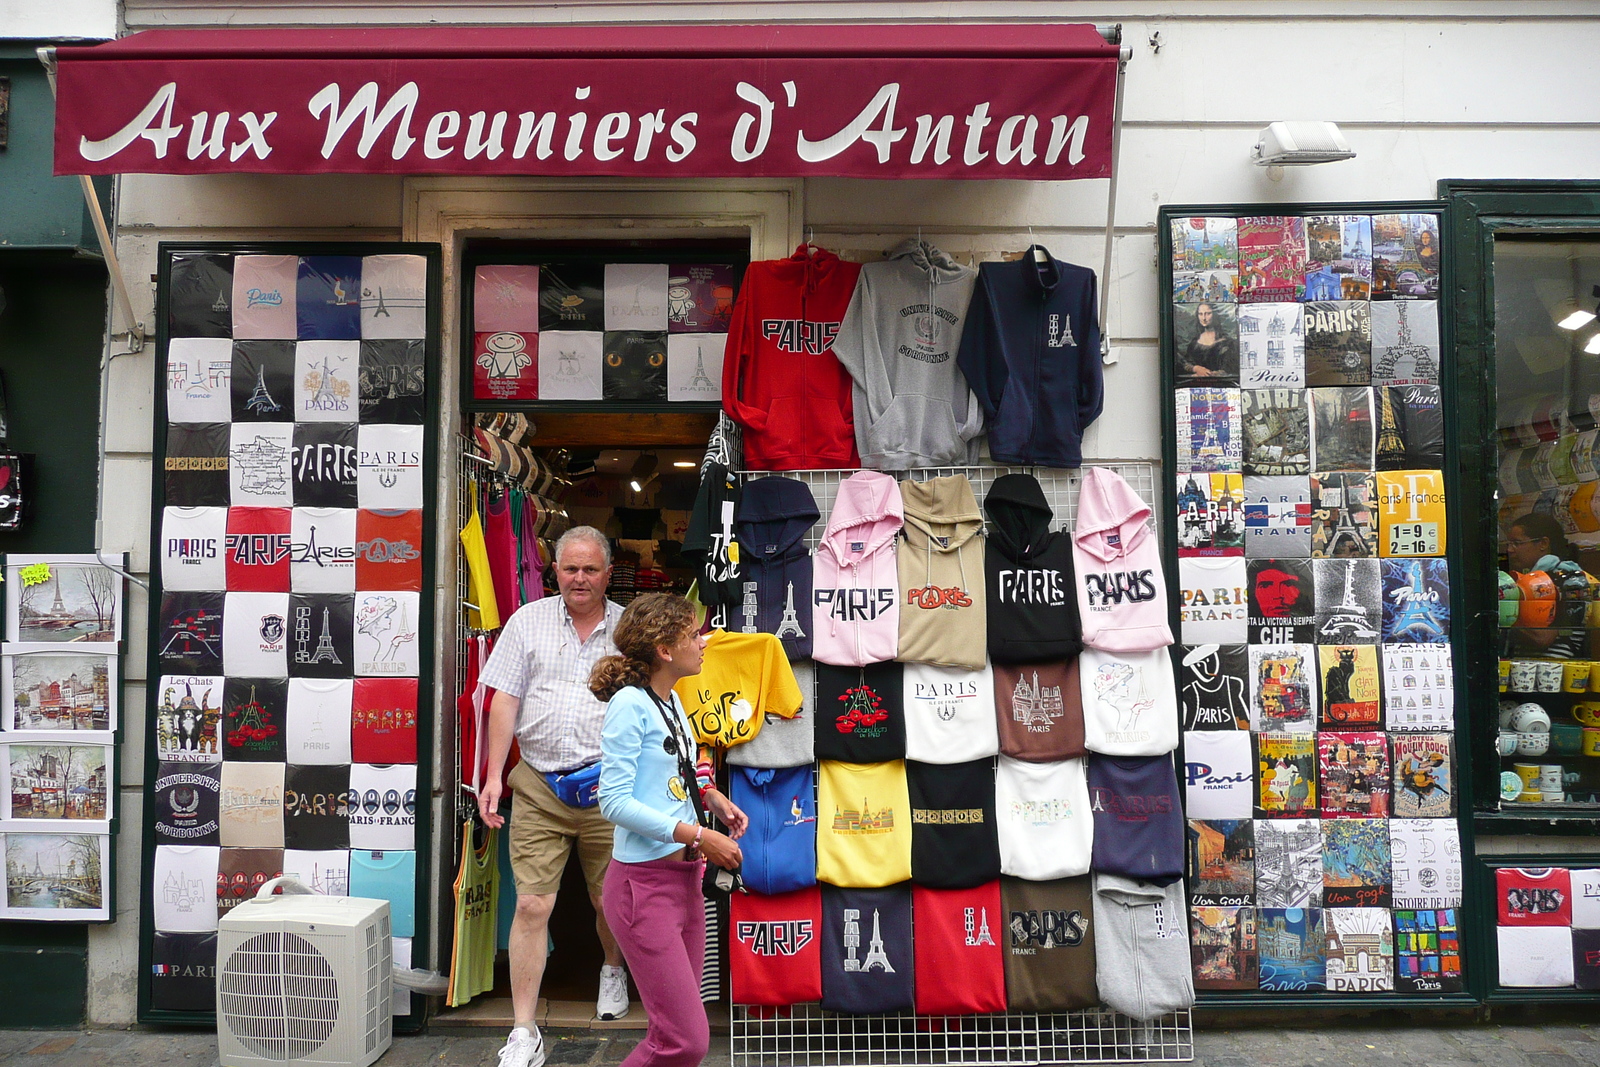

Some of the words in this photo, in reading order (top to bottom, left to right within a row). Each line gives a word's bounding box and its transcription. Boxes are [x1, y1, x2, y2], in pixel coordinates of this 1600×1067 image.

[80, 82, 278, 162] Aux
[308, 81, 698, 162] Meuniers
[730, 80, 1090, 166] d'Antan
[1245, 216, 1283, 226] PARIS
[247, 288, 283, 308] Paris
[900, 304, 959, 326] UNIVERSITE
[1305, 308, 1359, 336] PARIS
[762, 319, 841, 355] PARIS
[899, 345, 950, 364] SORBONNE
[1249, 369, 1299, 383] Paris
[1403, 386, 1439, 404] Paris
[305, 400, 349, 411] PARIS
[292, 444, 357, 483] PARIS
[360, 452, 418, 464] PARIS
[1244, 495, 1303, 503] ARI
[1405, 492, 1446, 504] France
[1245, 527, 1311, 535] RANC
[1413, 524, 1422, 538] 9
[169, 539, 216, 558] PARIS
[226, 534, 291, 565] PARIS
[1411, 540, 1426, 553] 16
[998, 569, 1065, 604] PARIS
[908, 585, 973, 609] PARIS
[1389, 587, 1439, 604] Paris
[814, 588, 894, 621] PARIS
[1258, 617, 1266, 626] LA
[1266, 617, 1292, 626] VICTORIA
[1292, 616, 1315, 625] SIEMPRE
[295, 606, 310, 664] PARIS
[1260, 627, 1294, 644] CHE
[362, 662, 406, 673] PARIS
[170, 677, 185, 685] Les
[187, 676, 213, 686] Chats
[915, 681, 977, 697] PARIS
[697, 689, 712, 705] Le
[1356, 688, 1377, 698] NOIR
[1028, 725, 1051, 733] PARIS
[1105, 731, 1150, 744] PARIS
[303, 742, 330, 750] PARIS
[1425, 742, 1448, 756] ROUGE
[167, 754, 211, 762] FRANCE
[285, 790, 348, 816] PARIS
[1091, 786, 1173, 814] PARIS
[350, 816, 374, 824] ARIS
[380, 816, 415, 825] FRANC
[155, 820, 219, 838] SORBONNE
[217, 898, 242, 908] ARIS
[1192, 895, 1215, 905] Van
[1327, 892, 1353, 904] Van
[1354, 888, 1388, 907] Gogh
[1430, 898, 1442, 908] DE
[1444, 897, 1462, 908] L'AR
[1010, 910, 1089, 949] PARIS
[737, 920, 813, 956] PARIS
[844, 909, 860, 972] PARIS
[171, 965, 216, 977] PARI
[1259, 961, 1325, 992] Paris
[1333, 977, 1388, 991] PARIS
[1413, 979, 1441, 989] Paris
